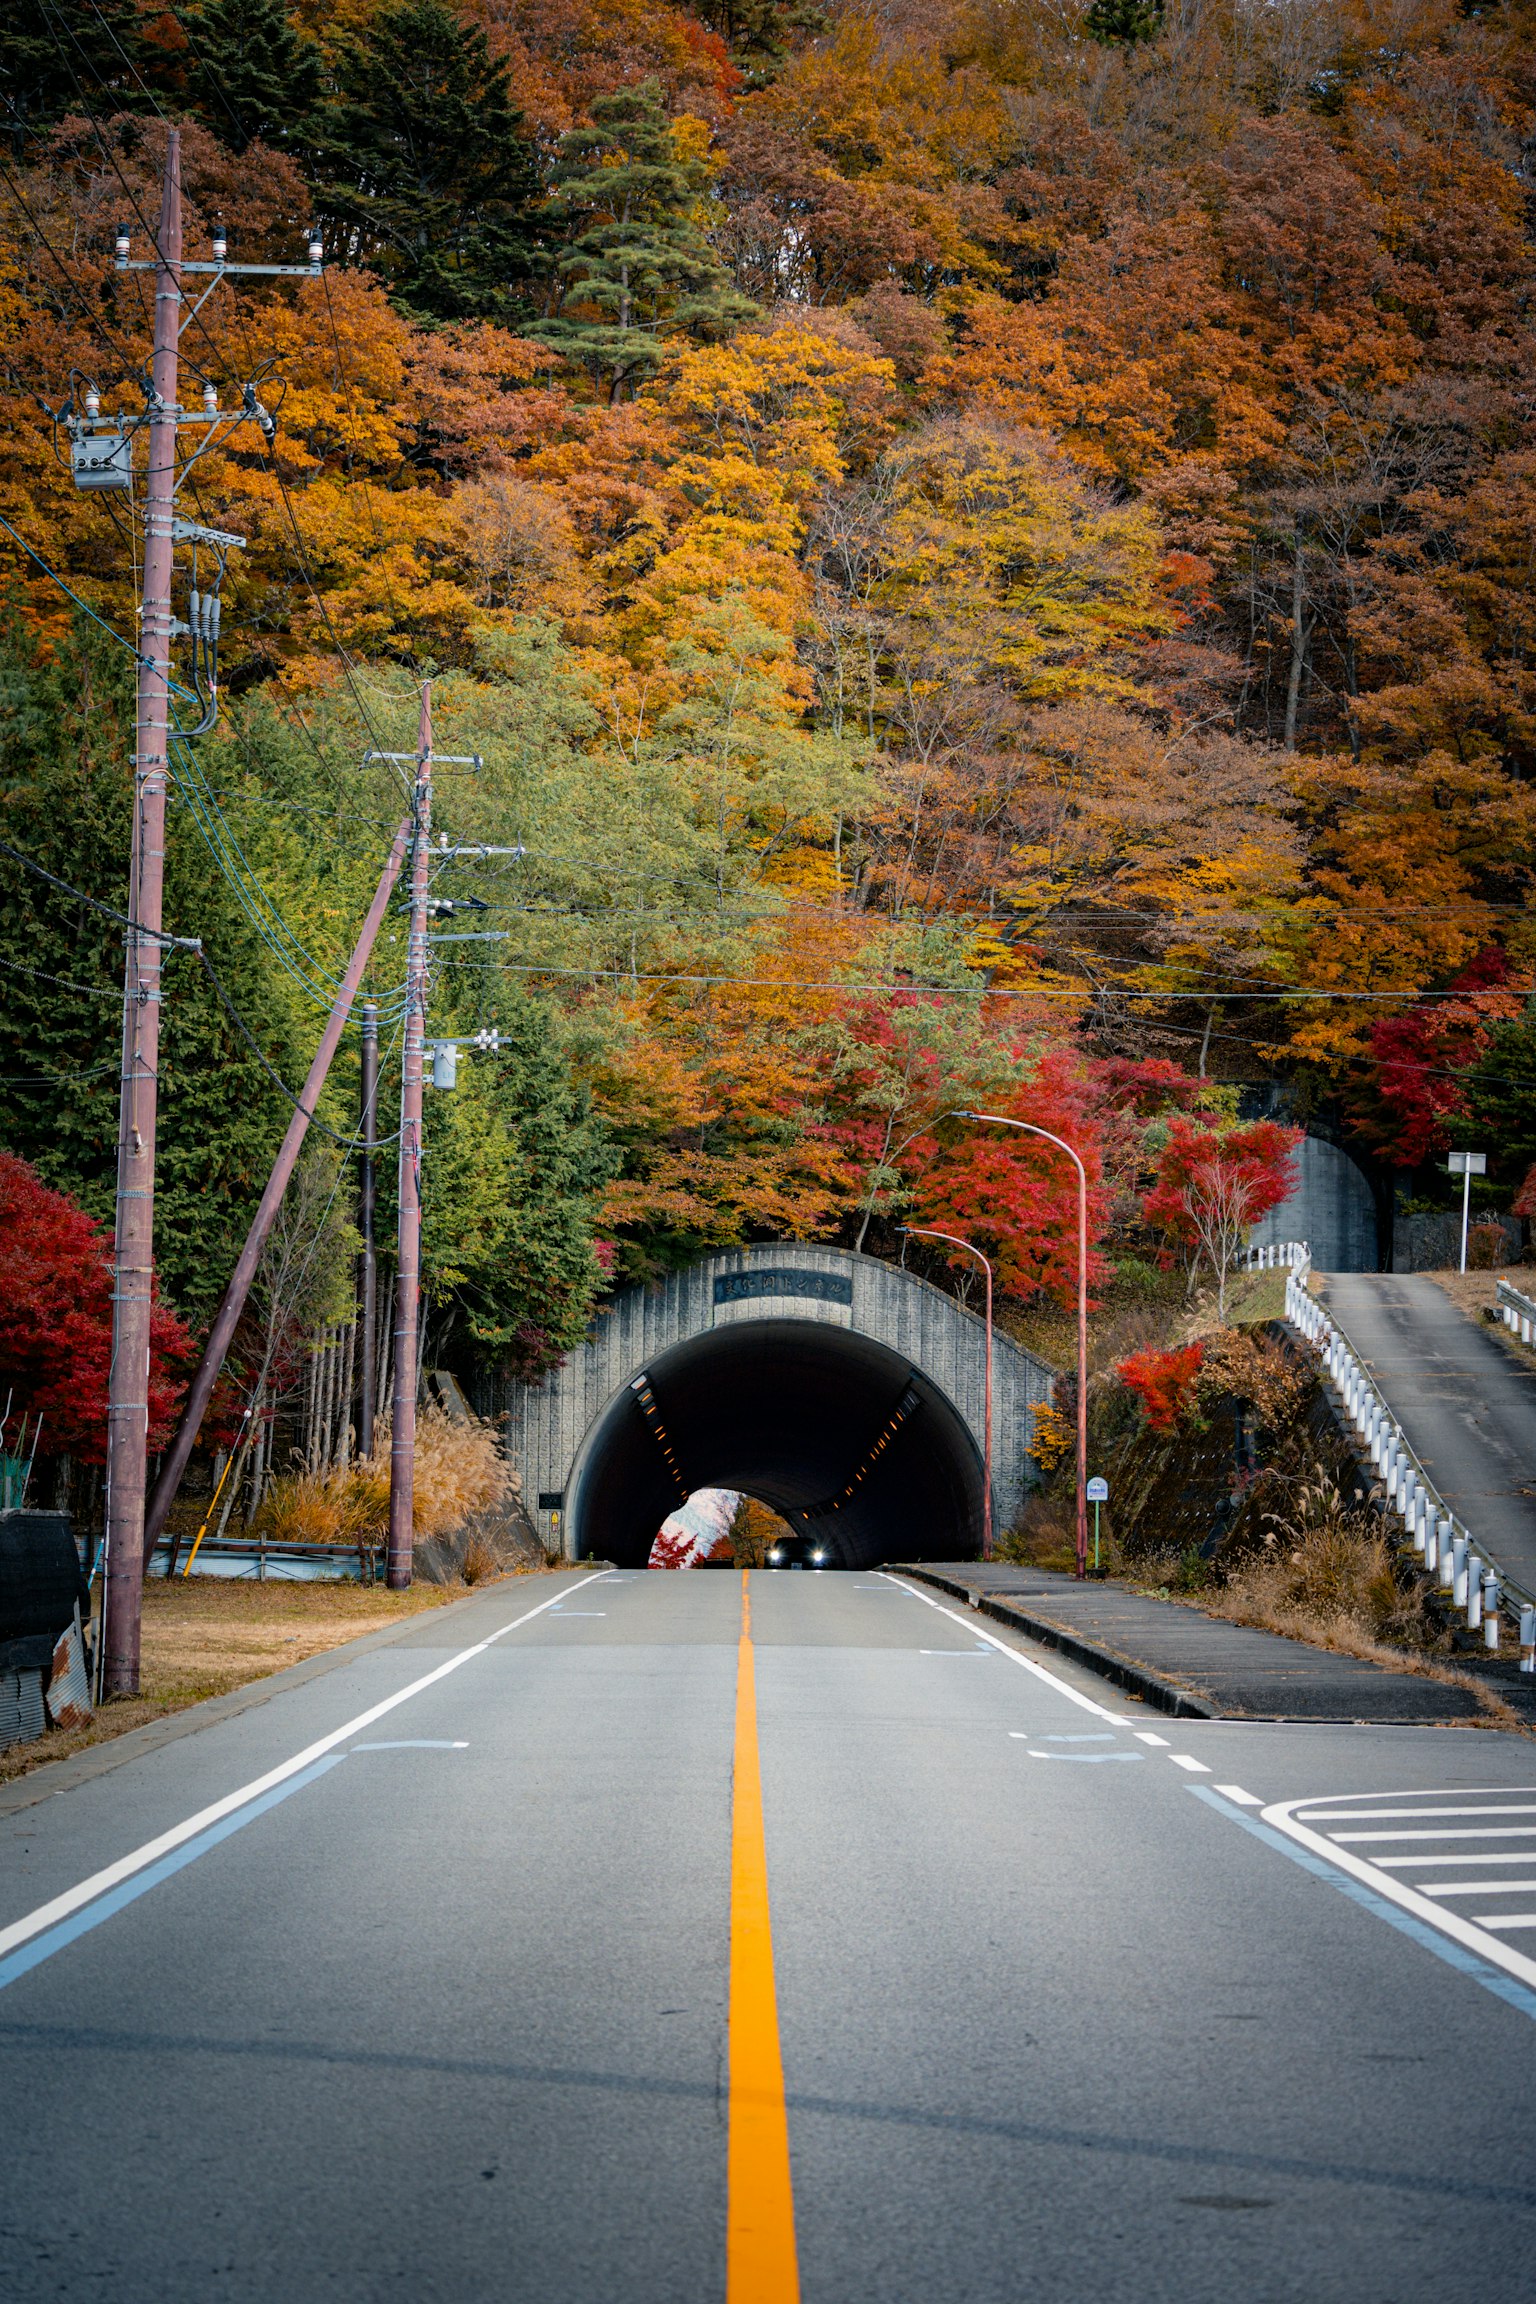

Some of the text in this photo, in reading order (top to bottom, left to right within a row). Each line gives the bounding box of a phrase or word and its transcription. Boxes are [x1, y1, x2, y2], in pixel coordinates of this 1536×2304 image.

[725, 1275, 842, 1294] 文化洞トンネル
